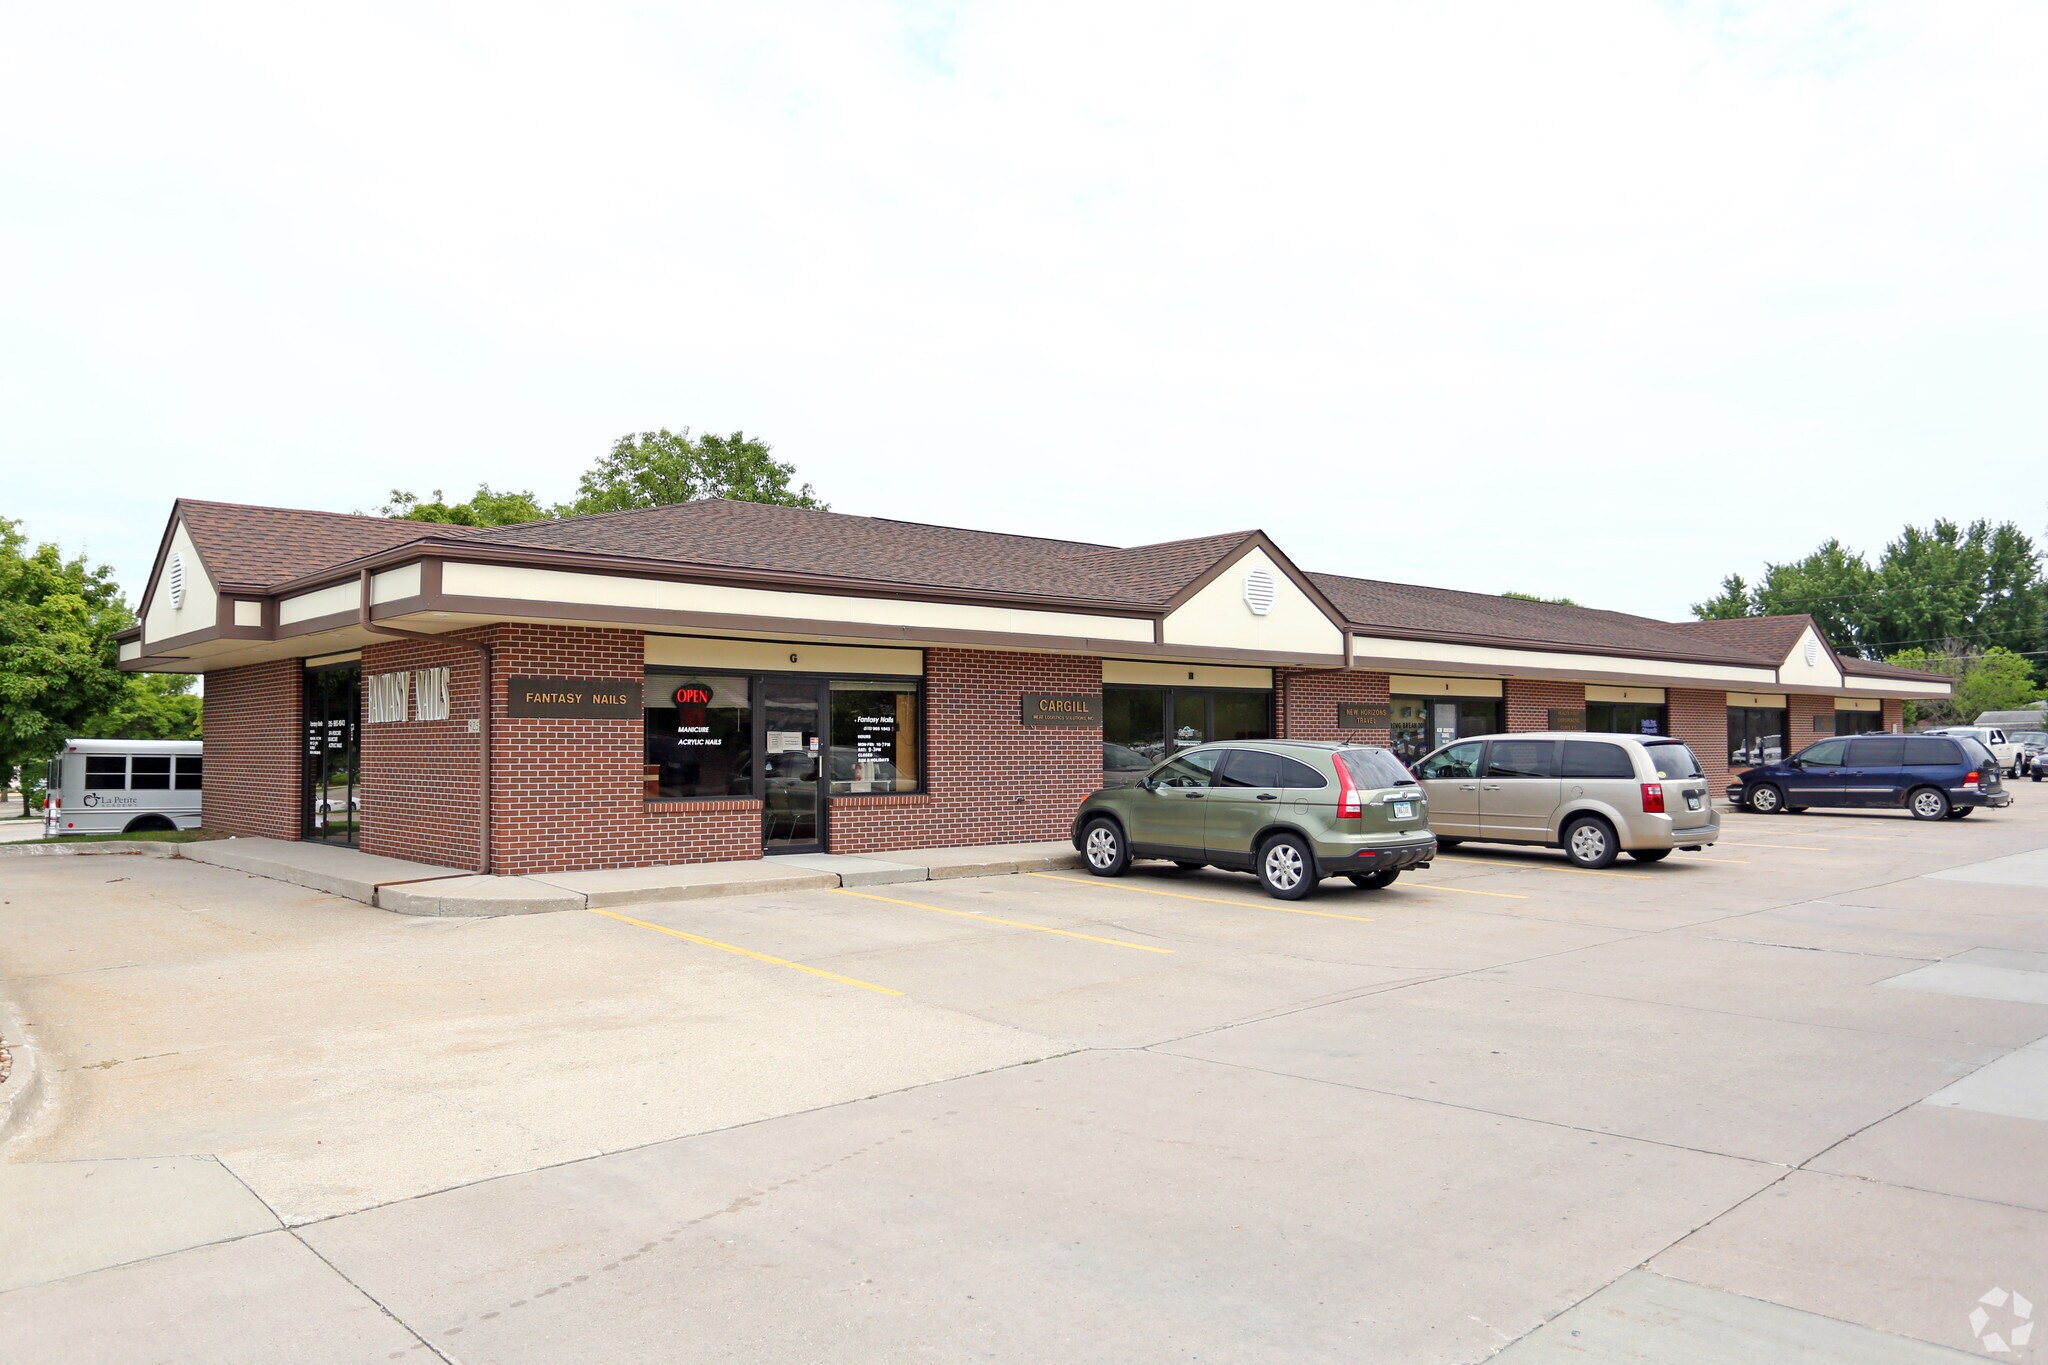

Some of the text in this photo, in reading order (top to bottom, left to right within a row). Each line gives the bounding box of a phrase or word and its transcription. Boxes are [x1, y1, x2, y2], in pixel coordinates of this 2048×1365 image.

[789, 653, 798, 663] G
[368, 667, 451, 723] FANTASY NAILS
[526, 692, 627, 705] FANTASY NAILS
[677, 688, 709, 703] OPEN
[1039, 699, 1089, 713] CARGILL
[1360, 709, 1387, 717] HORIZONS
[857, 716, 880, 724] Fantasy
[101, 796, 138, 804] La Petite
